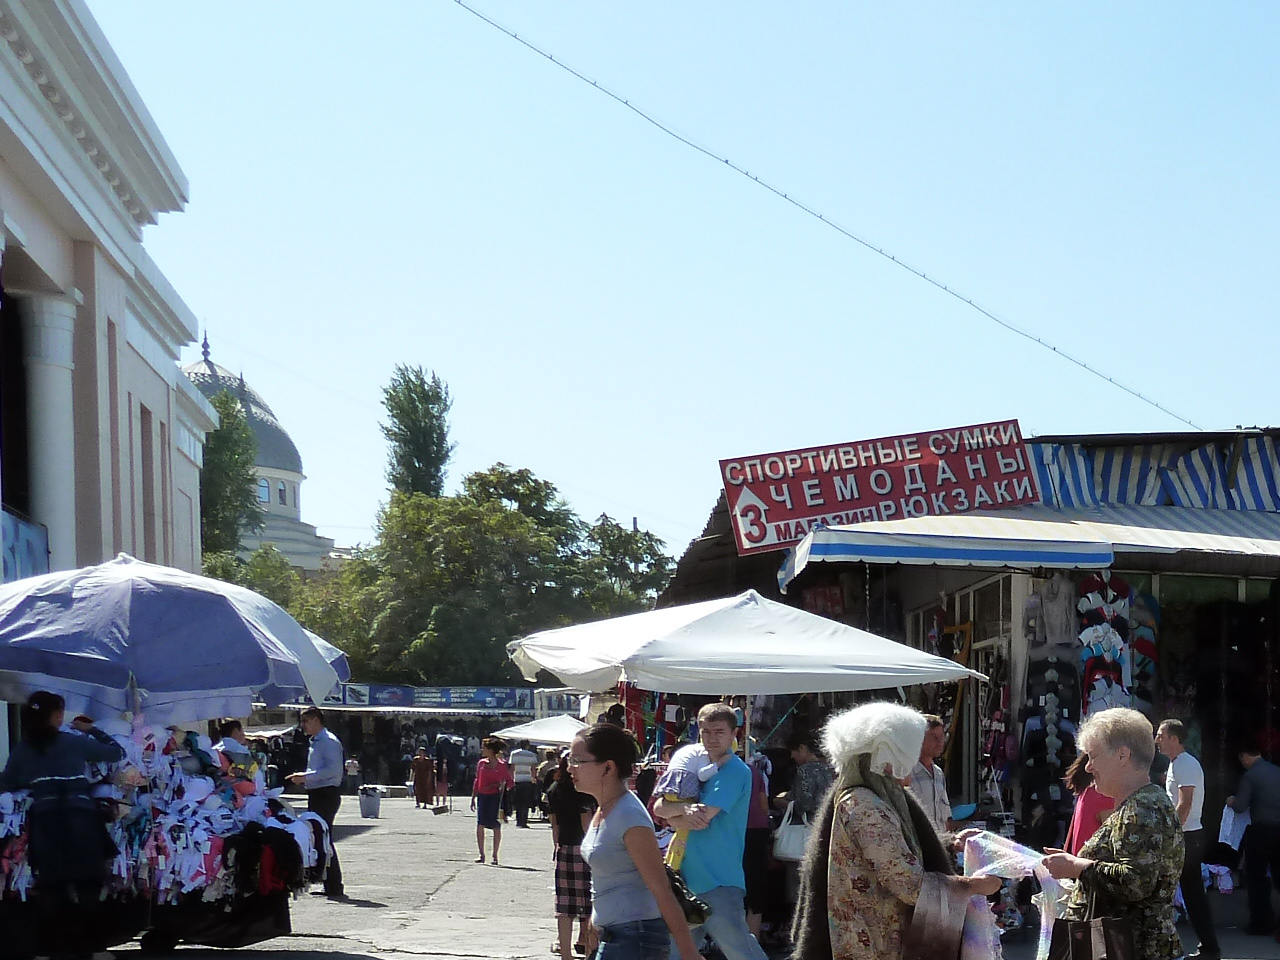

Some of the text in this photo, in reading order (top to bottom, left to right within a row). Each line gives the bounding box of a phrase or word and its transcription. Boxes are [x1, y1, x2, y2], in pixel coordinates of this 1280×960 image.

[725, 423, 1019, 485] СПОРТИВНЫЕ СУМКИ
[769, 448, 1026, 509] ЧЕМОДАНЫ
[740, 503, 767, 543] 3
[878, 476, 1034, 521] РЮКЗАКИ
